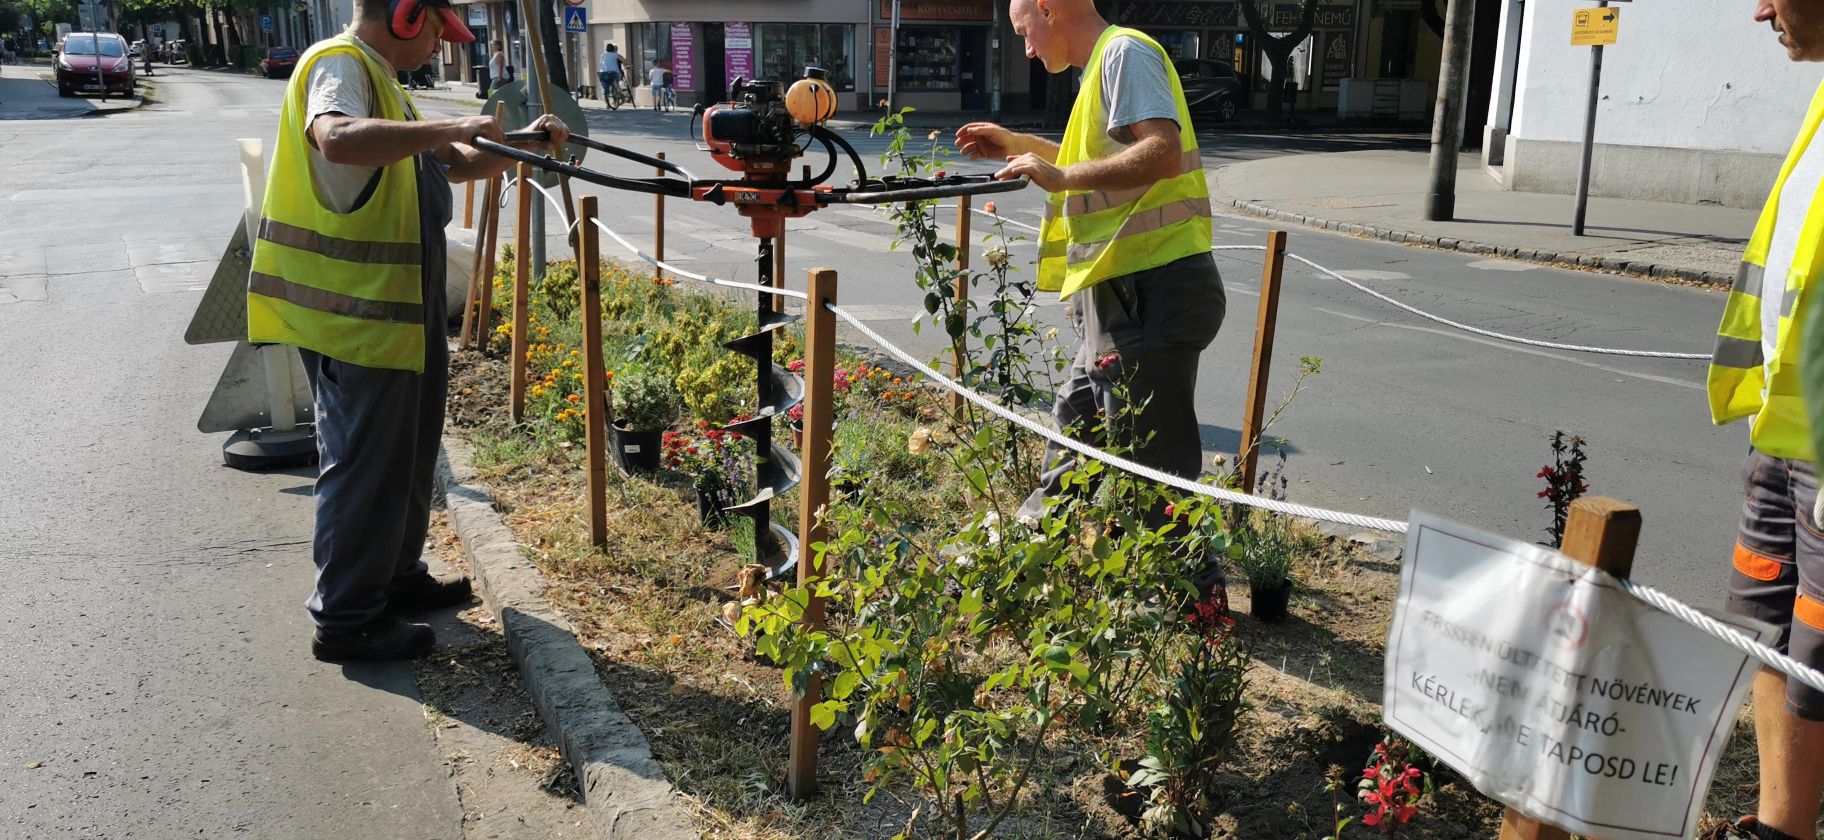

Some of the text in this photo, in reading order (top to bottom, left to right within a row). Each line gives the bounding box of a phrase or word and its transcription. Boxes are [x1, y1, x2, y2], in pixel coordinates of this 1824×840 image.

[1419, 610, 1493, 653] FRSSEN
[1591, 678, 1701, 714] NÖVÉNYEK
[1540, 734, 1636, 779] TAPOSD
[1642, 761, 1679, 787] LE!
